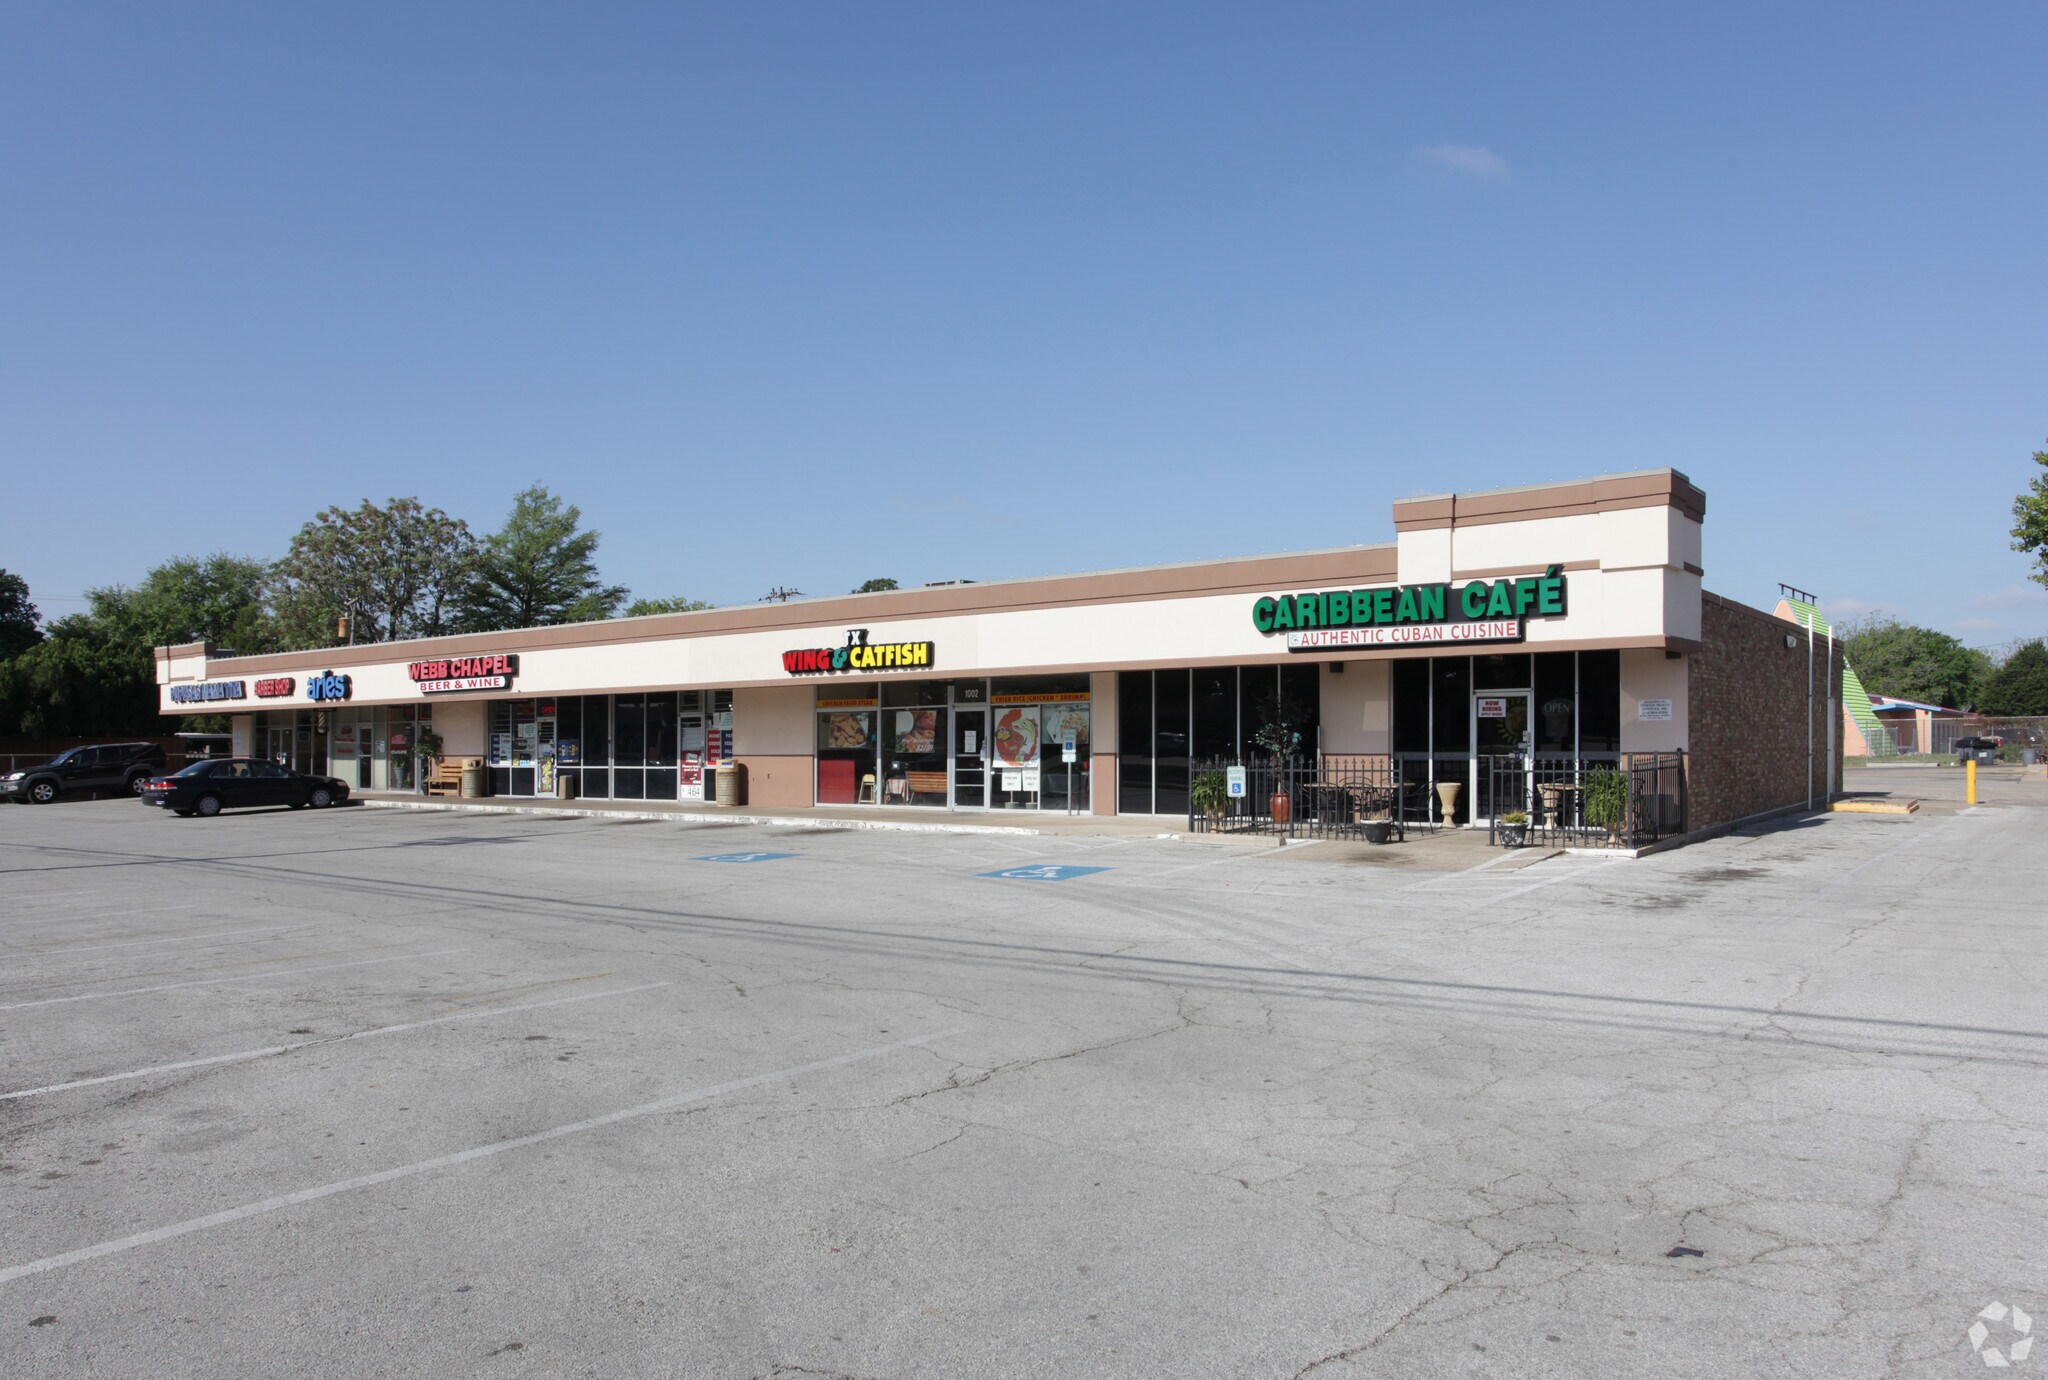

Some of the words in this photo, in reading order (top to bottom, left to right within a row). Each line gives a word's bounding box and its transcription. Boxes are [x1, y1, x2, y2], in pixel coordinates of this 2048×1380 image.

[1253, 586, 1445, 632] CARIBBEAN
[1461, 567, 1563, 618] CAFÉ
[844, 630, 861, 646] TX
[1301, 629, 1385, 646] AUTHENTIC
[1391, 625, 1443, 642] CUBAN
[1451, 622, 1517, 639] CUISINE
[782, 649, 830, 671] WING
[832, 648, 848, 669] &
[850, 643, 928, 668] CATFISH
[407, 661, 449, 681] WEBB
[450, 655, 513, 678] CHAPEL
[275, 679, 290, 695] SHOP
[307, 671, 345, 700] aries
[420, 681, 451, 691] BEER
[454, 680, 463, 689] &
[467, 677, 501, 688] WINE
[965, 689, 979, 698] 1002
[1544, 703, 1570, 713] OPEN
